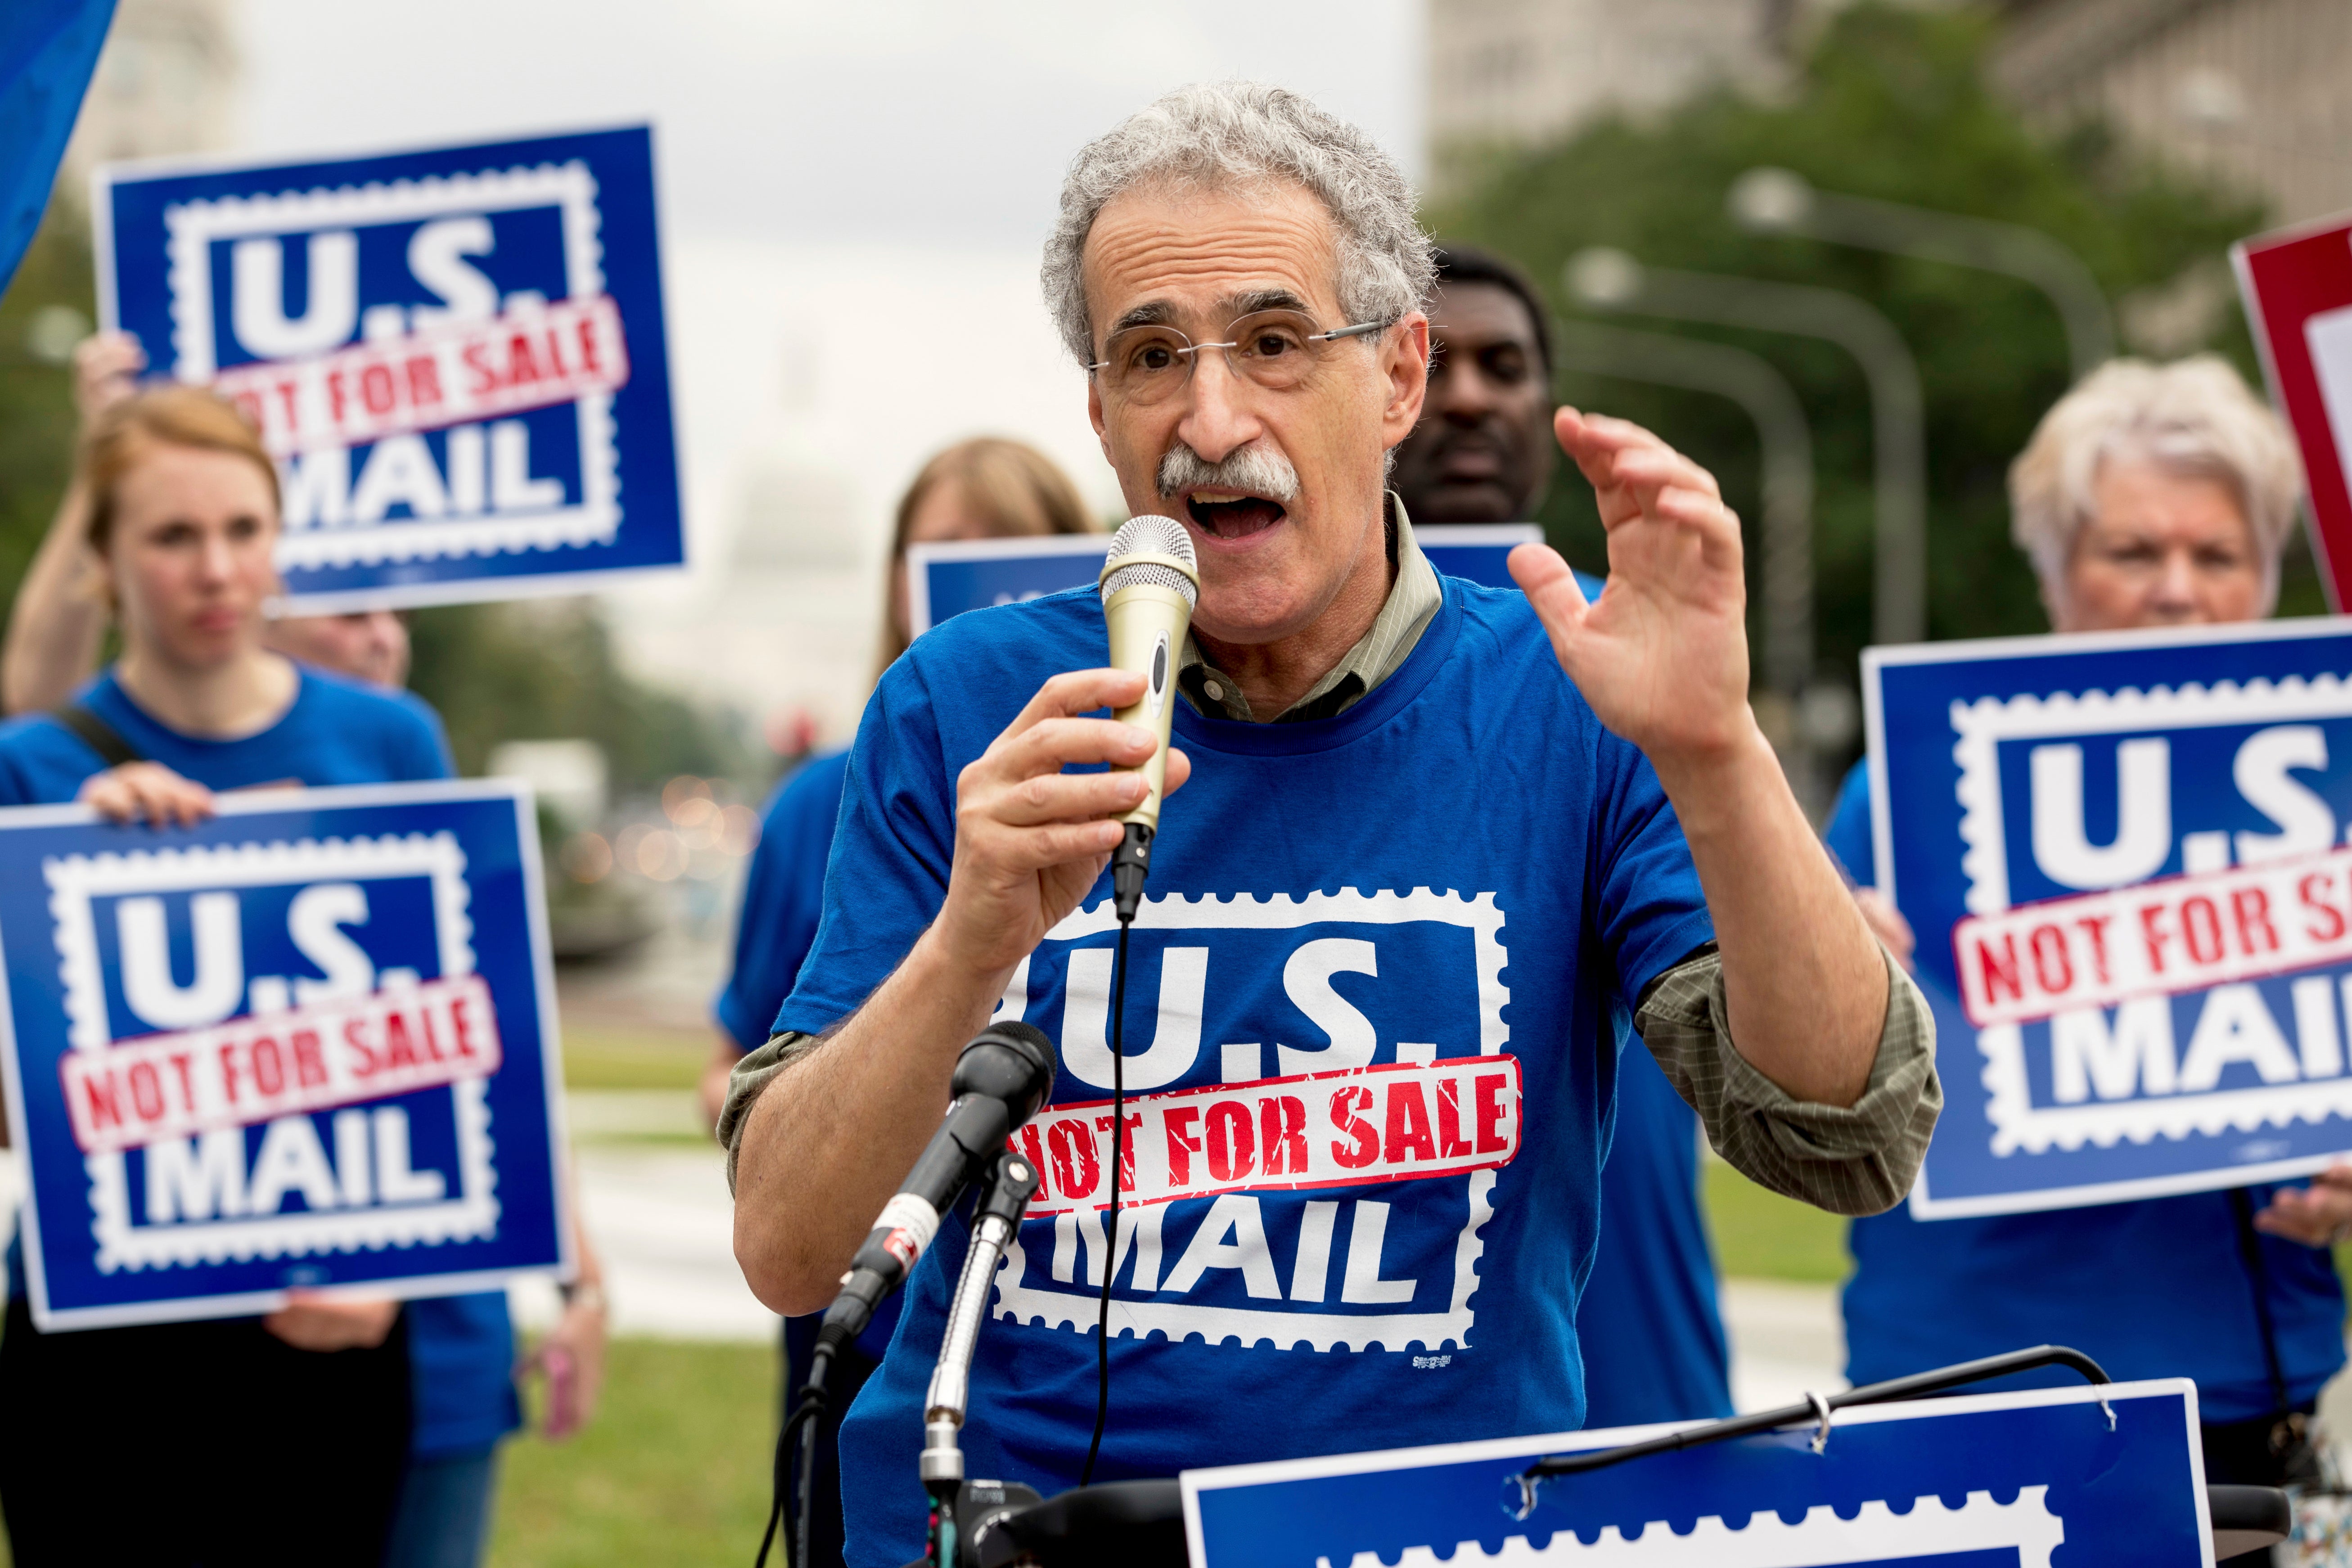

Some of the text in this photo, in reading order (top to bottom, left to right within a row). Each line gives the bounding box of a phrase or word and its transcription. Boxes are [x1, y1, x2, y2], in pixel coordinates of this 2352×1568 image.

[230, 215, 548, 358] U.S.
[325, 354, 443, 424] FOR
[461, 318, 601, 398] SALE
[116, 881, 422, 1029] U.S.
[1976, 915, 2116, 1007] NOT
[2138, 886, 2281, 975] FOR
[82, 997, 477, 1131] NOT FOR SALE
[1061, 937, 1437, 1090] U.S.
[2050, 973, 2352, 1105] MAI
[142, 1106, 446, 1225] MAIL
[1163, 1095, 1310, 1187] FOR
[1329, 1073, 1508, 1169] SALE
[1052, 1194, 1417, 1304] MAIL
